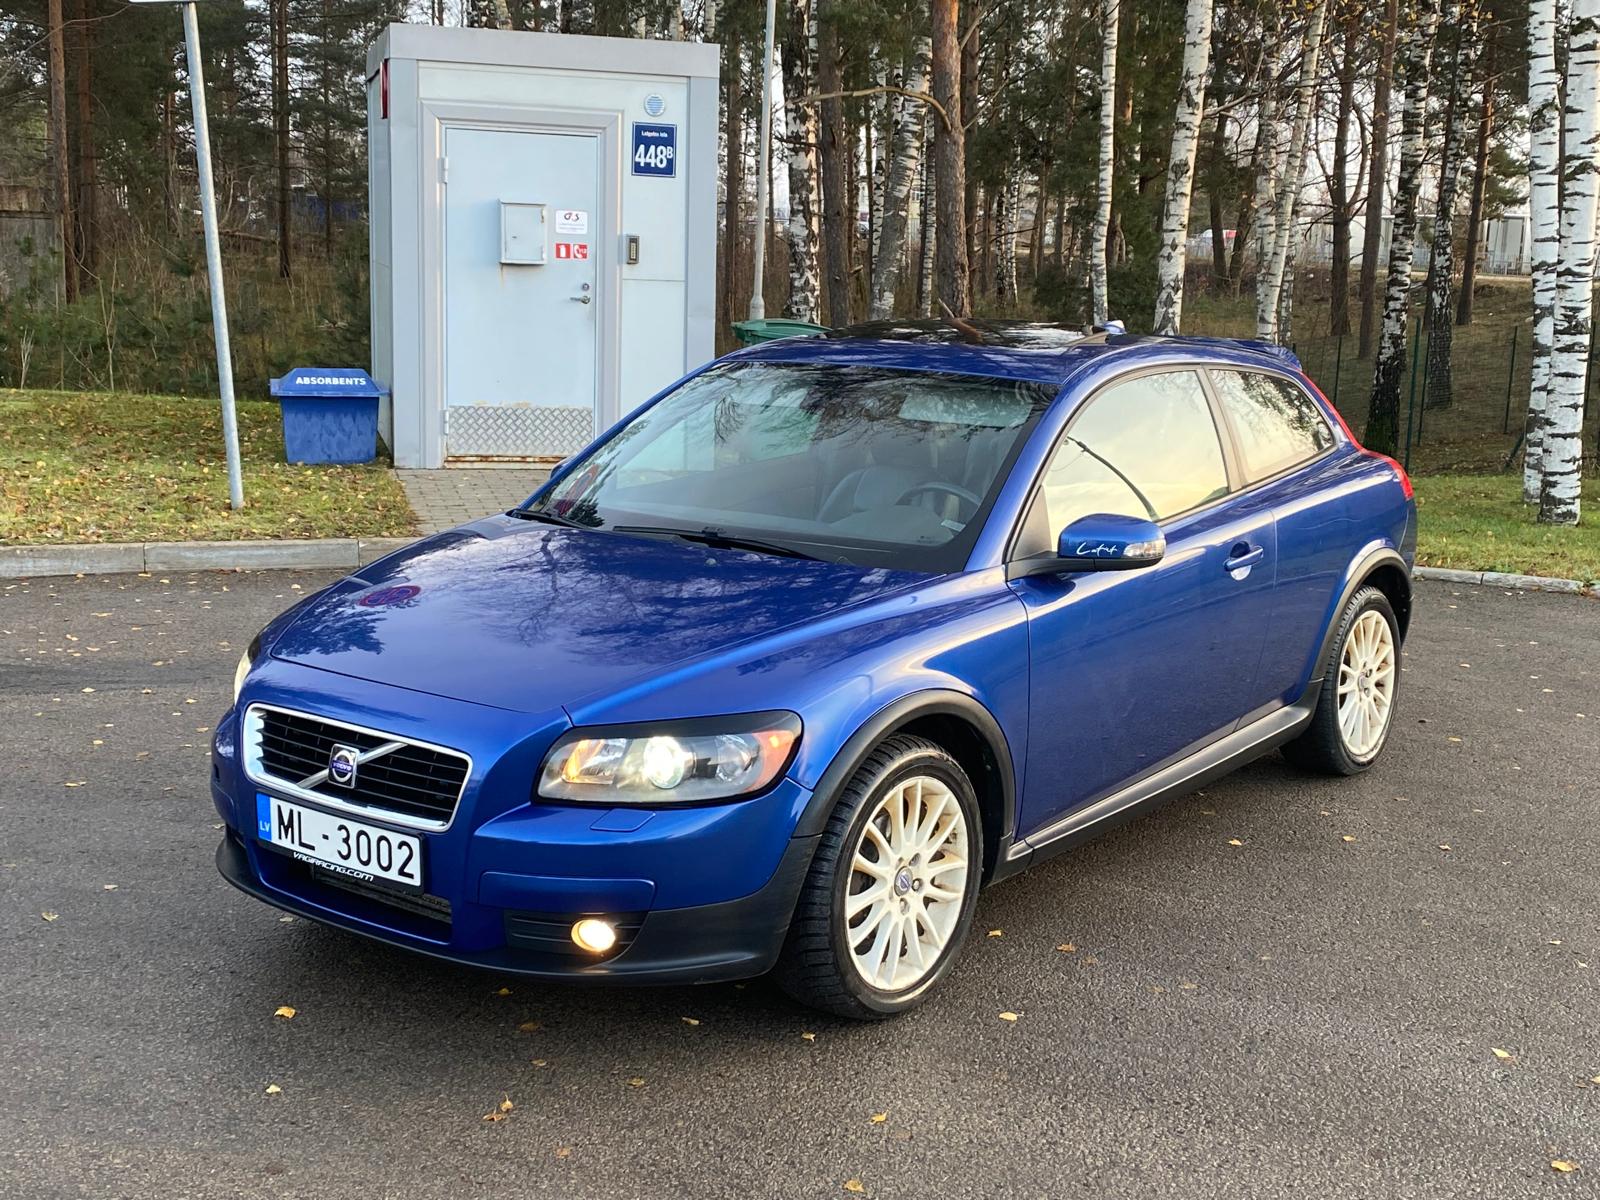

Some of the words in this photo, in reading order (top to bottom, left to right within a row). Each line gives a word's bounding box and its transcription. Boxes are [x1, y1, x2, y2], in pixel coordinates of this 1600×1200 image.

[564, 212, 580, 222] GS
[295, 377, 366, 386] ABSORBENTS
[259, 822, 270, 832] LV
